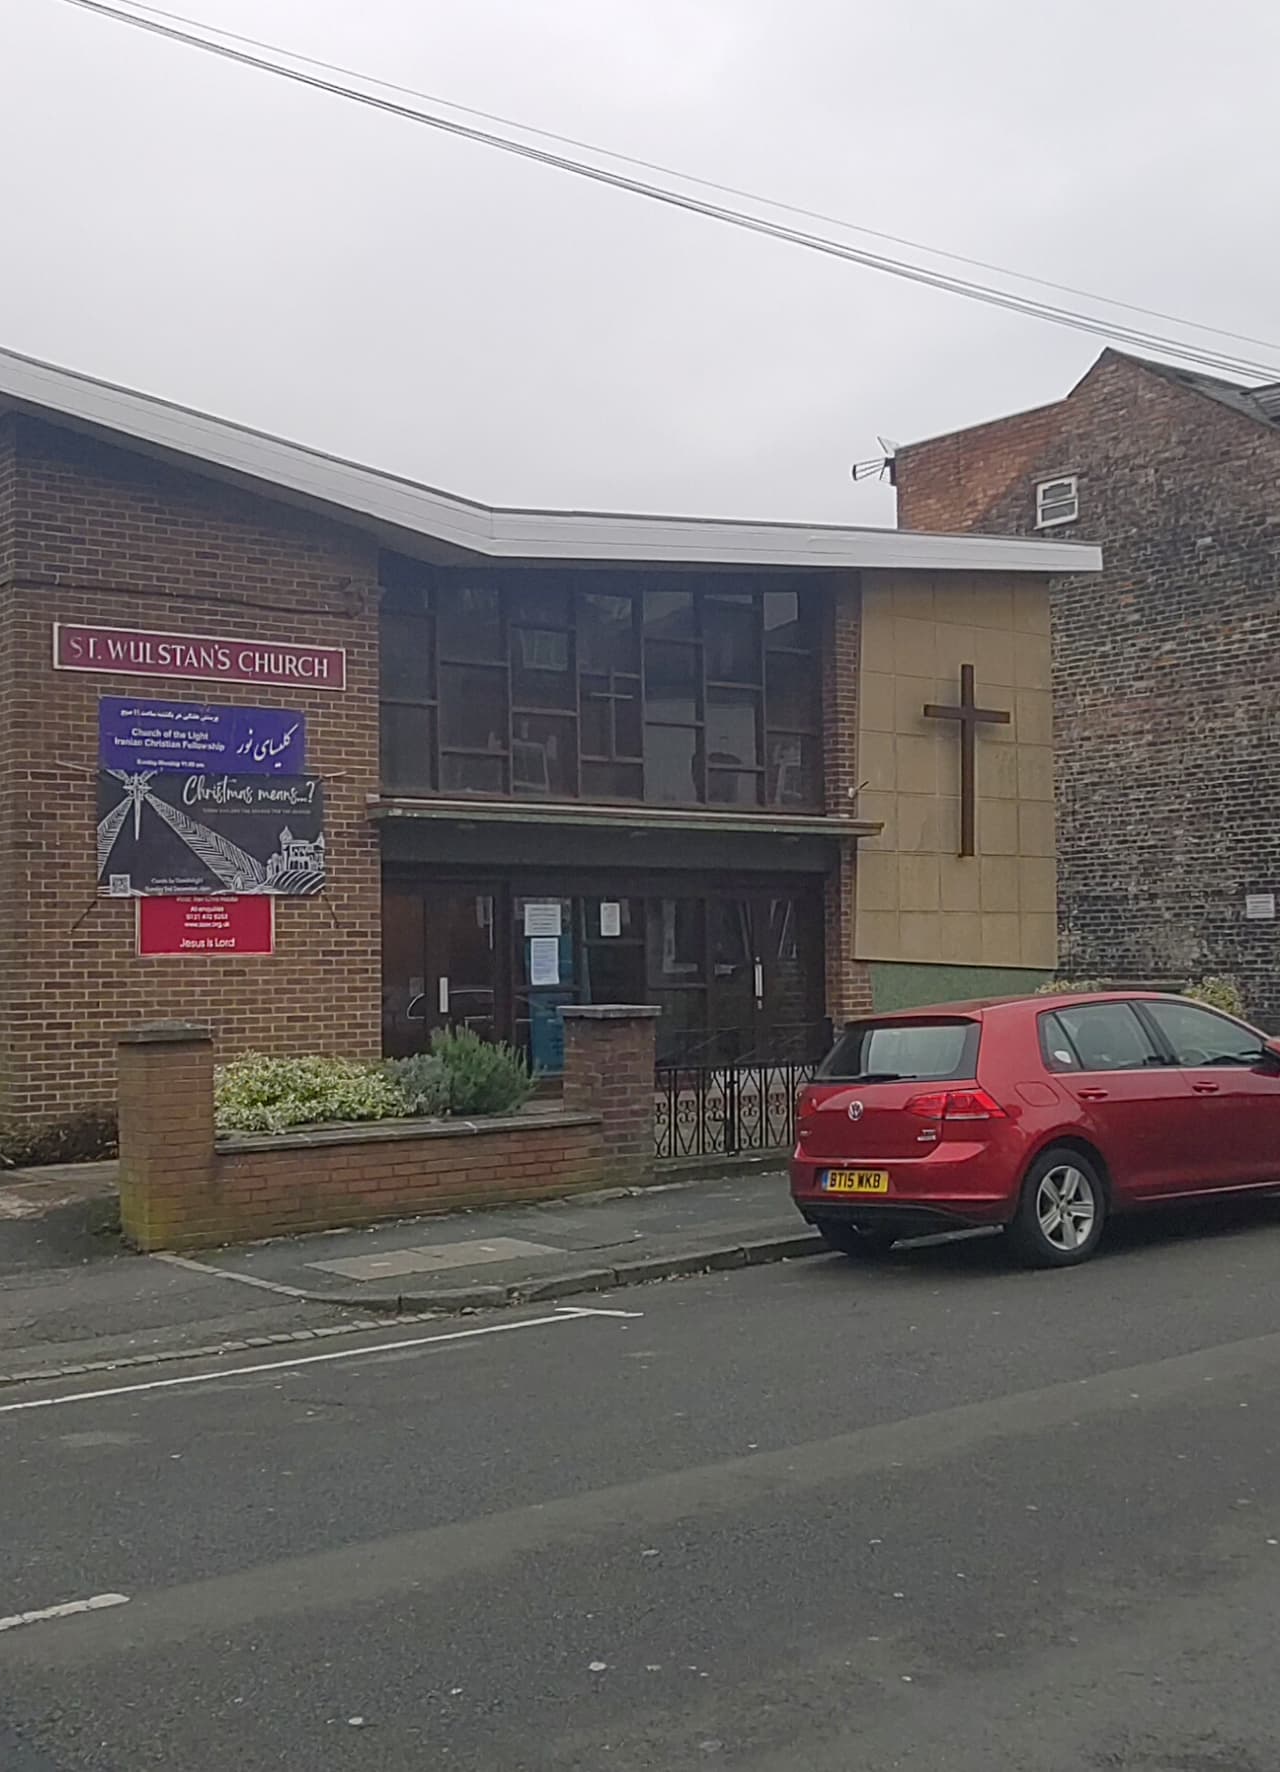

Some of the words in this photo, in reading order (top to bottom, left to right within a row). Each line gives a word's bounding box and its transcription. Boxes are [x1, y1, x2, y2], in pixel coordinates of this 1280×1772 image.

[70, 636, 102, 660] ST.
[108, 639, 231, 671] WULSTAN'S
[238, 651, 328, 678] CHURCH
[131, 727, 161, 738] Church
[163, 729, 172, 738] of
[173, 730, 186, 739] the
[188, 731, 209, 741] Light
[114, 736, 142, 746] Iranian
[144, 738, 181, 749] Christian
[182, 741, 225, 752] Fellowship
[183, 775, 253, 805] Christmas
[179, 937, 205, 948] Jesus
[206, 937, 214, 948] is
[215, 937, 235, 948] Lord
[830, 1171, 855, 1188] BT15
